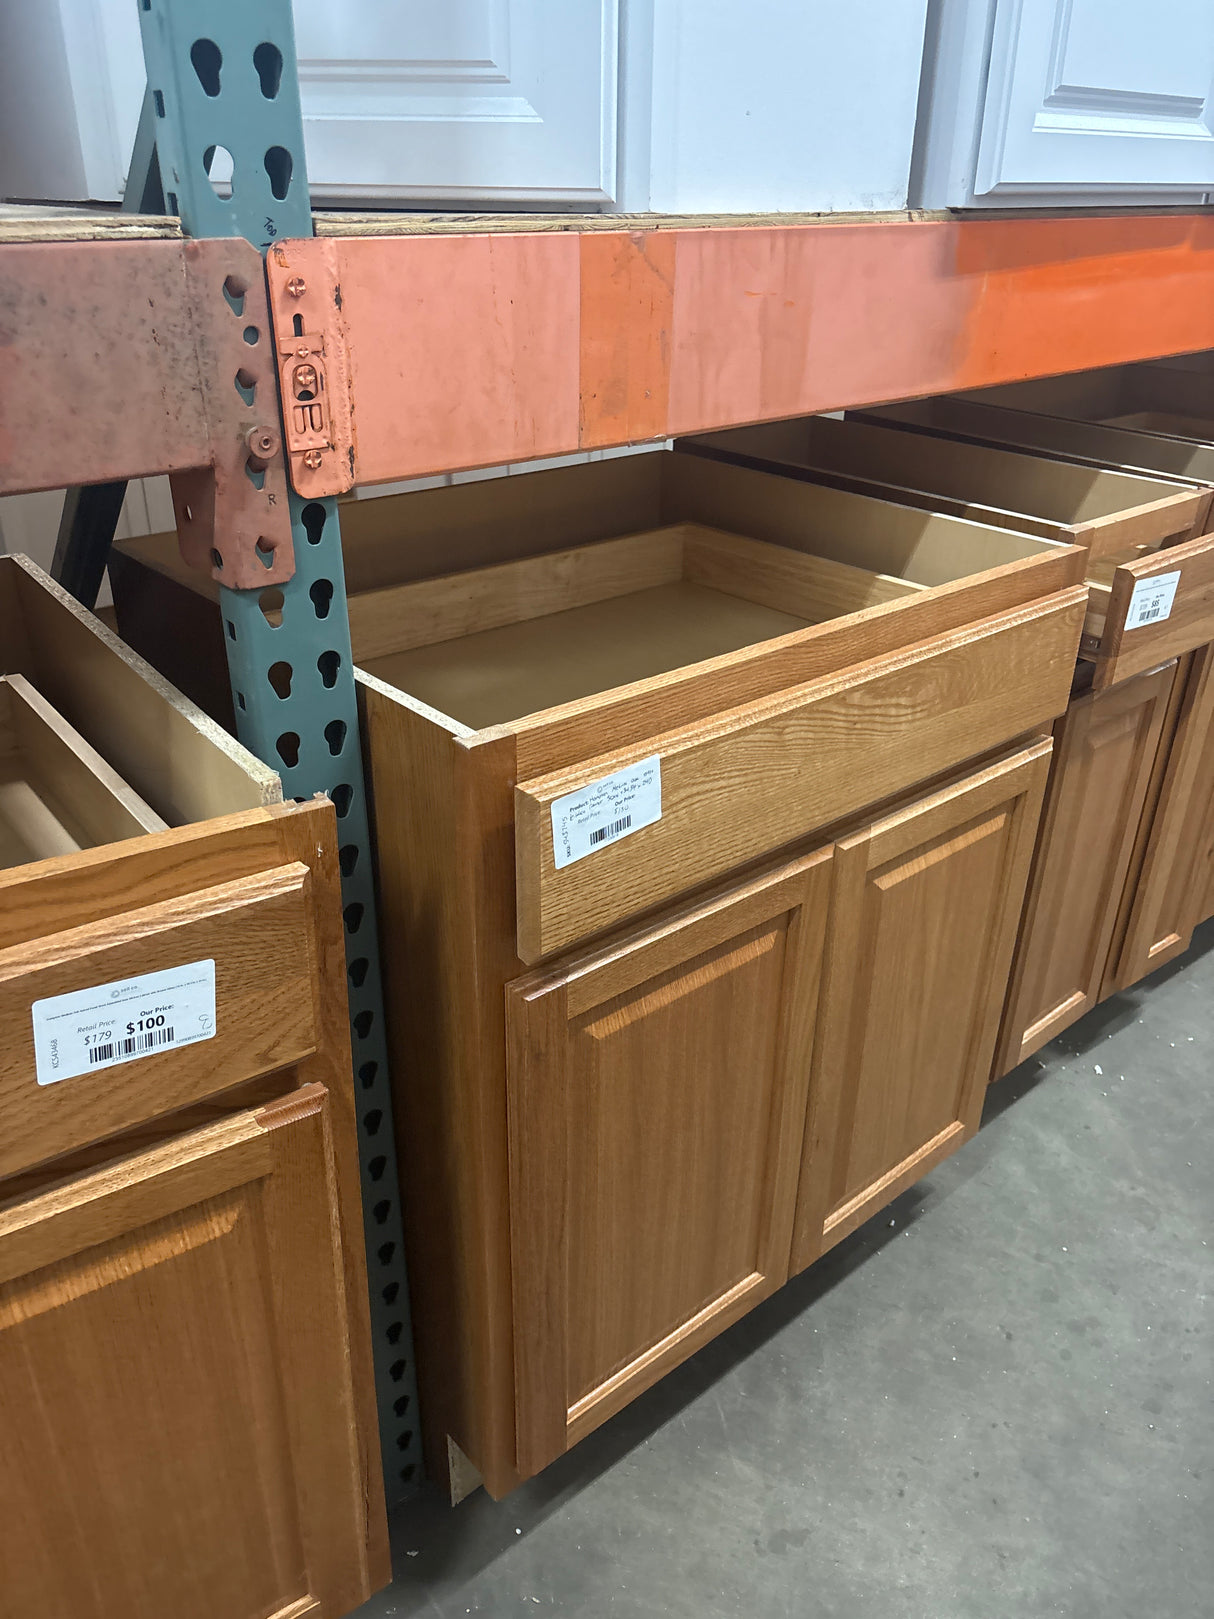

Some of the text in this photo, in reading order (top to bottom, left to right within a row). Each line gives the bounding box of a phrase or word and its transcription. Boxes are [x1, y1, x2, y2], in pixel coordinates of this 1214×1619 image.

[268, 494, 276, 505] R
[140, 1004, 175, 1017] Our Price:
[77, 1022, 96, 1034] Retail
[126, 1015, 165, 1036] $100
[84, 1030, 112, 1046] $179
